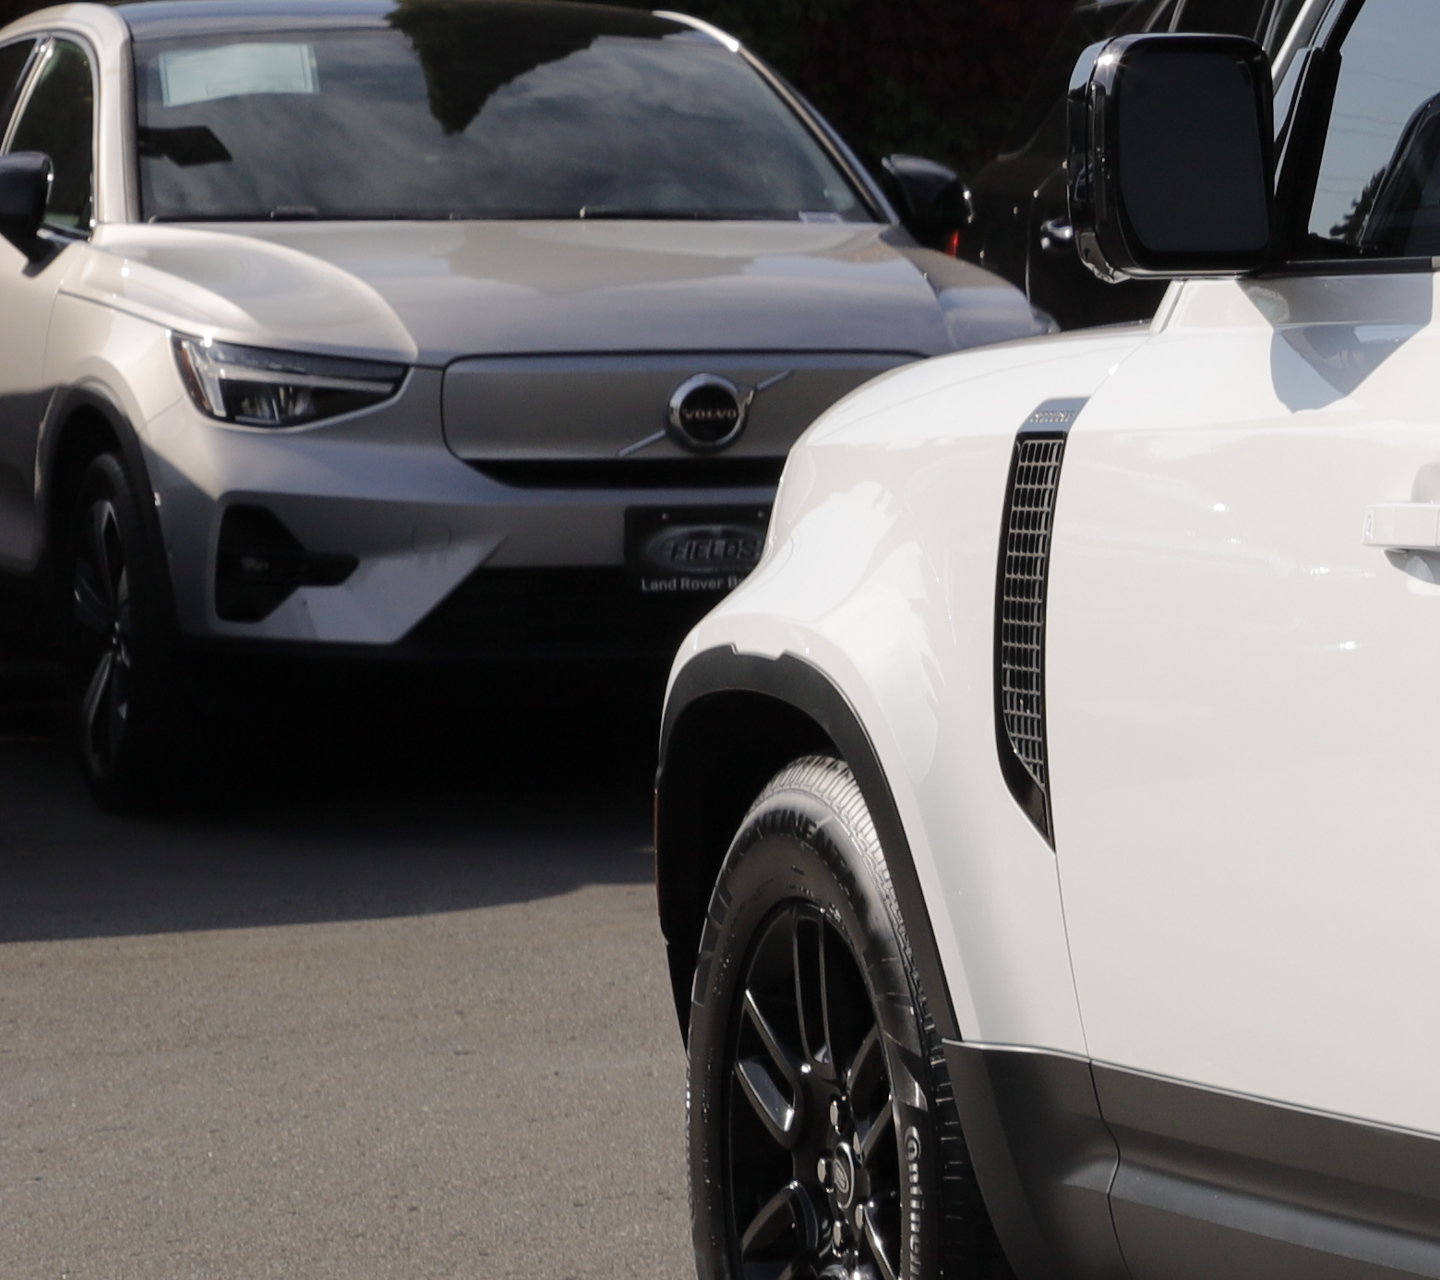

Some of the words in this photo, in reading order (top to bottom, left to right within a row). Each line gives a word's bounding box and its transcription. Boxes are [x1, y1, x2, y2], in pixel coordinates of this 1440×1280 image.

[682, 409, 738, 420] VOLVO
[641, 576, 677, 592] Land
[681, 576, 724, 591] Rover
